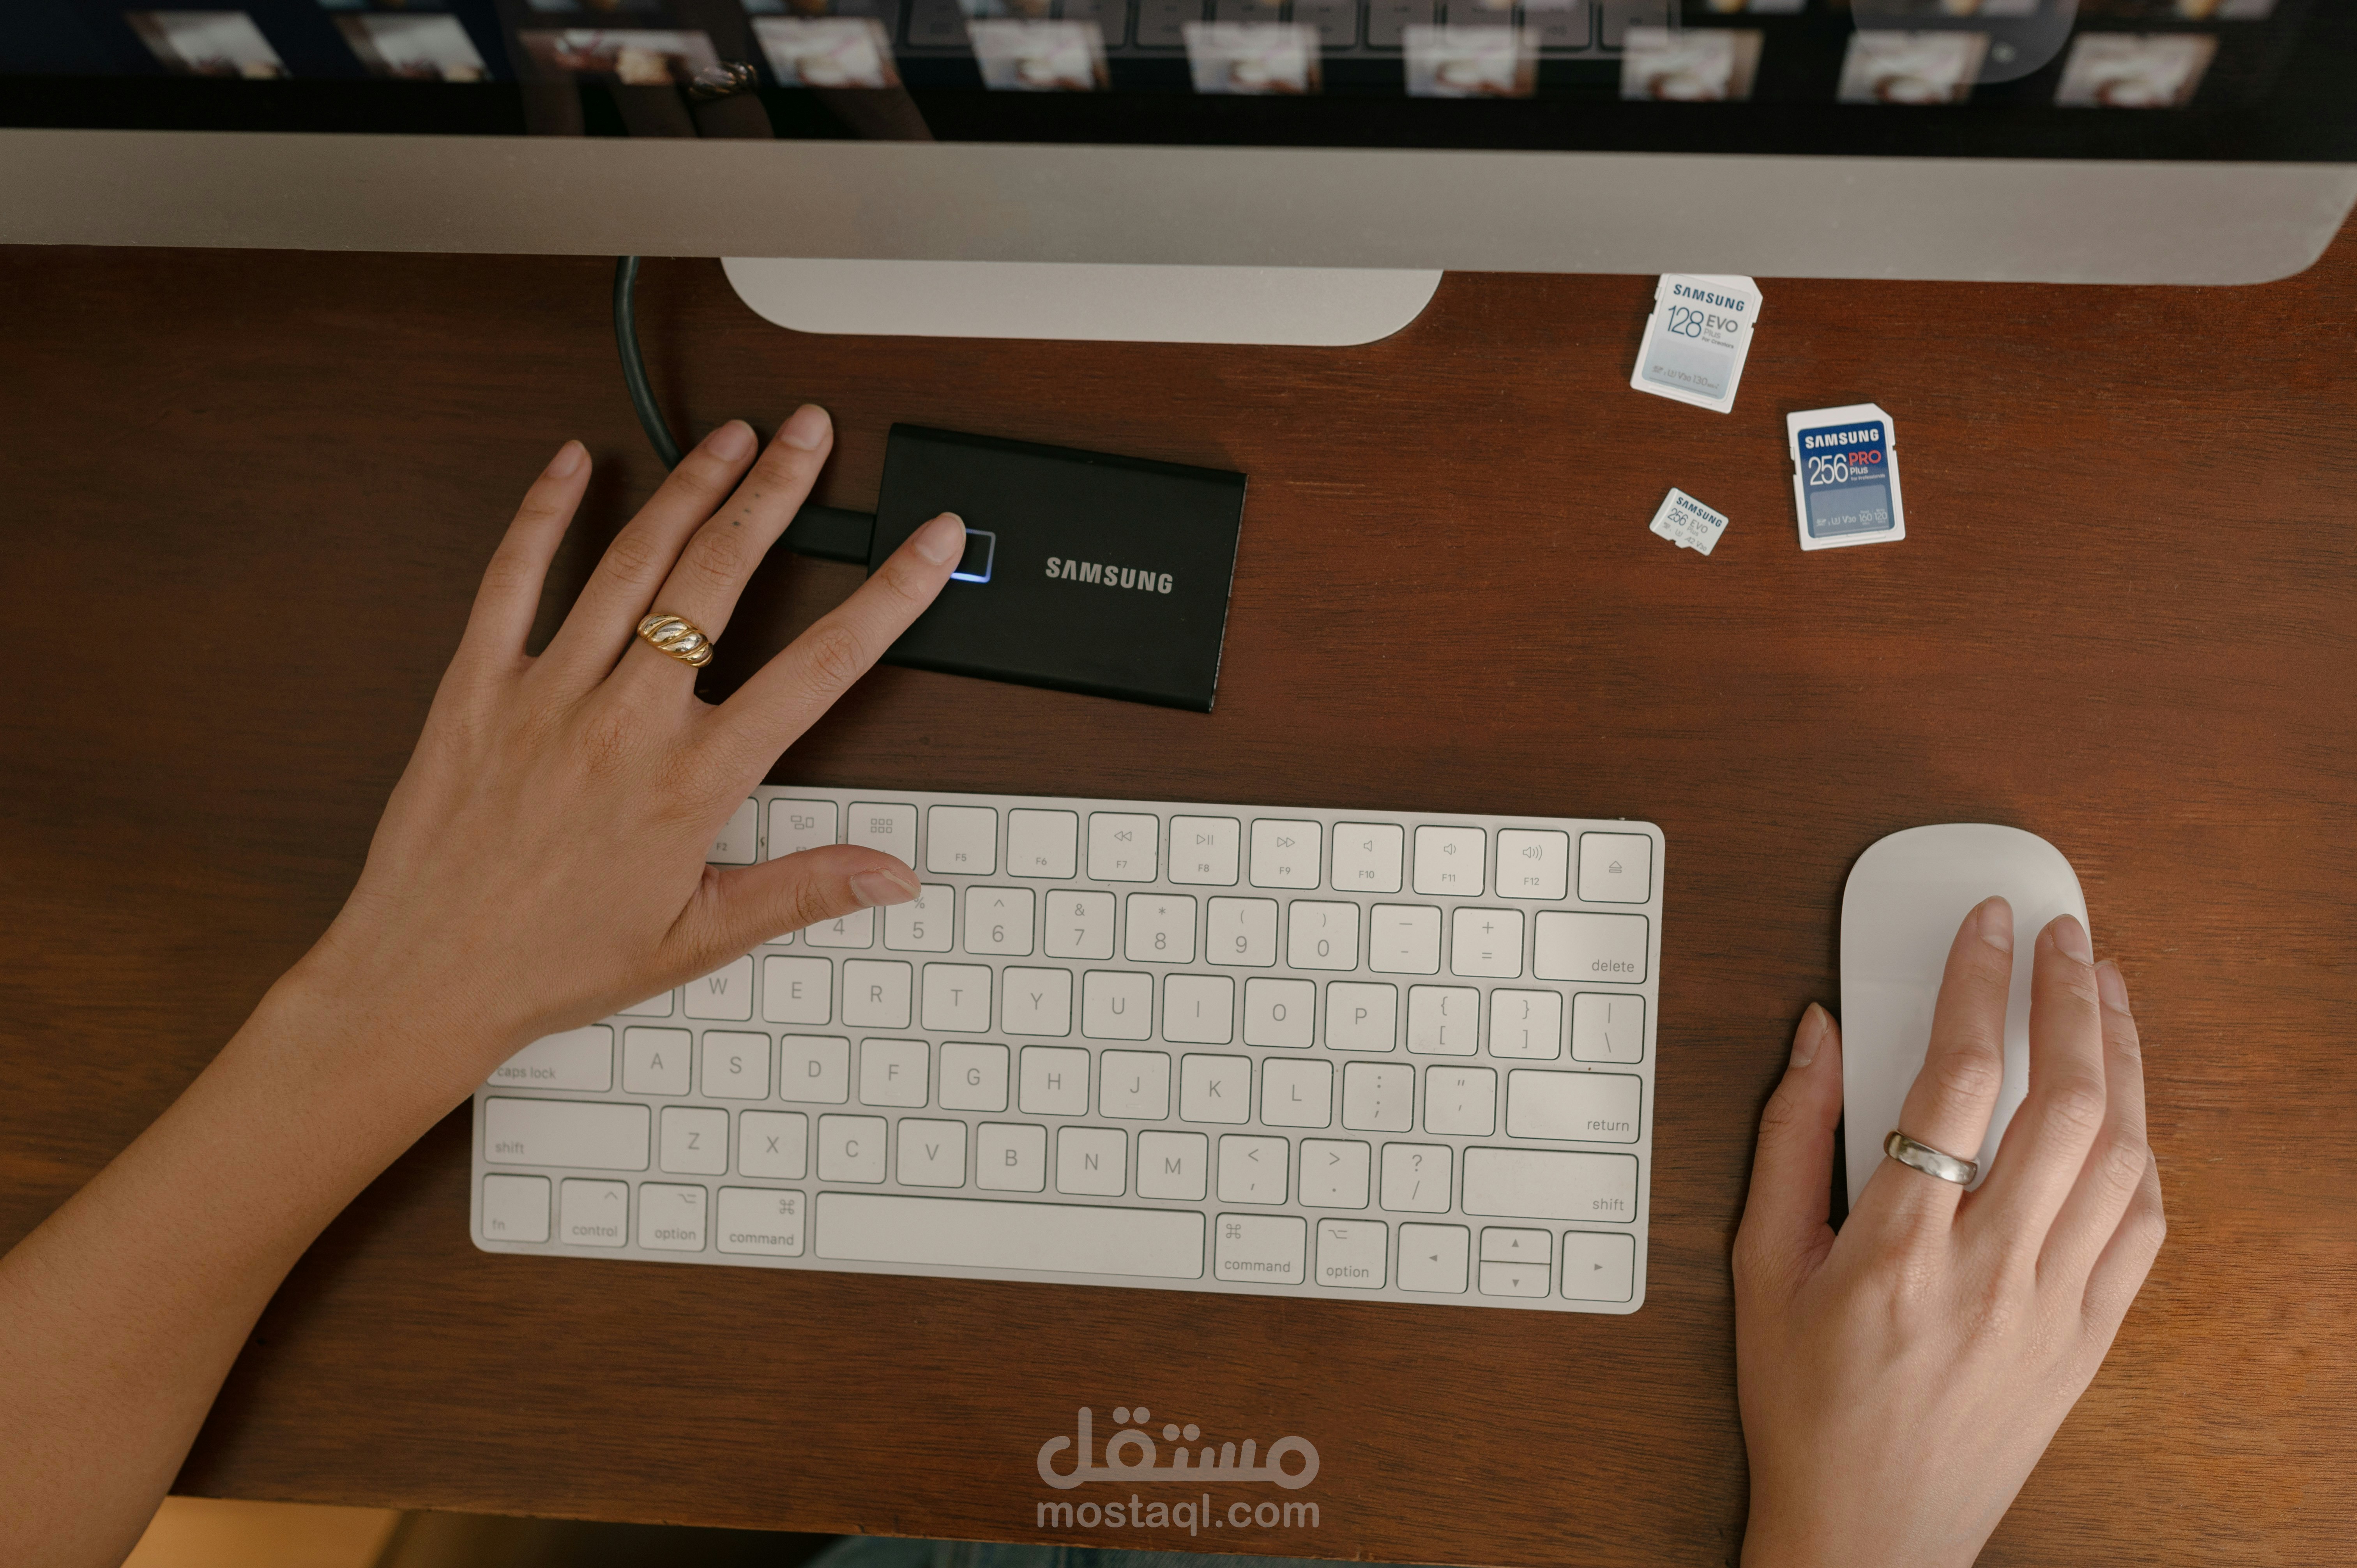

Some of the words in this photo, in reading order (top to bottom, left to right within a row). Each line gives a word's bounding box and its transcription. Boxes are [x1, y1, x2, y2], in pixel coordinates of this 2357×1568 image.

[1673, 284, 1745, 312] SAMSUNG
[1668, 305, 1704, 338] 128
[1706, 314, 1738, 333] EVO
[1703, 328, 1721, 339] Plus
[1805, 429, 1879, 449] SAMSUNG
[1848, 450, 1881, 466] PRO
[1808, 453, 1848, 486] 256
[1850, 466, 1869, 476] Plus
[1667, 508, 1688, 526] 256
[1677, 496, 1722, 528] SAMSUNG
[1842, 515, 1856, 524] V30
[1859, 513, 1872, 523] 160
[1874, 511, 1887, 521] 120
[1687, 526, 1699, 537] Plus
[1690, 519, 1708, 533] EVO
[1696, 541, 1707, 551] V30
[1046, 556, 1173, 594] SAMSUNG
[716, 842, 727, 851] F2
[955, 853, 967, 862] F5
[1036, 857, 1047, 866] F6
[1116, 860, 1127, 869] F7
[1198, 864, 1210, 872] F8
[1279, 867, 1291, 875] F9
[1359, 870, 1375, 879] F10
[1442, 874, 1456, 882] F11
[1524, 877, 1539, 886] F12
[1074, 903, 1085, 916] &
[832, 918, 845, 935] 4
[913, 921, 924, 939] 5
[992, 925, 1004, 943] 6
[1074, 929, 1085, 946] 7
[1154, 932, 1166, 950] 8
[1235, 936, 1247, 954] 9
[1317, 939, 1330, 957] 0
[1592, 959, 1634, 973] delete
[708, 977, 728, 995] W
[792, 981, 802, 999] E
[870, 985, 882, 1003] R
[951, 989, 963, 1006] T
[1030, 992, 1043, 1010] Y
[1112, 997, 1125, 1015] U
[1272, 1003, 1286, 1022] O
[1355, 1008, 1367, 1025] P
[650, 1052, 663, 1070] A
[730, 1056, 742, 1074] S
[808, 1060, 822, 1078] D
[497, 1067, 527, 1079] caps
[530, 1066, 555, 1079] lock
[888, 1064, 899, 1081] F
[967, 1068, 980, 1086] G
[1048, 1073, 1061, 1090] H
[1130, 1076, 1140, 1094] J
[1209, 1080, 1221, 1098] K
[1292, 1084, 1302, 1102] L
[1587, 1120, 1629, 1132] return
[495, 1142, 524, 1154] shift
[687, 1132, 700, 1150] Z
[766, 1136, 779, 1153] X
[845, 1140, 859, 1158] C
[925, 1144, 939, 1161] V
[1005, 1149, 1018, 1167] B
[1085, 1153, 1098, 1171] N
[1165, 1157, 1181, 1174] M
[1412, 1154, 1422, 1172] ?
[1593, 1198, 1624, 1211] shift
[492, 1218, 505, 1230] fn
[572, 1225, 618, 1237] control
[654, 1228, 696, 1241] option
[729, 1233, 794, 1246] command
[1224, 1261, 1290, 1273] command
[1326, 1265, 1369, 1279] option
